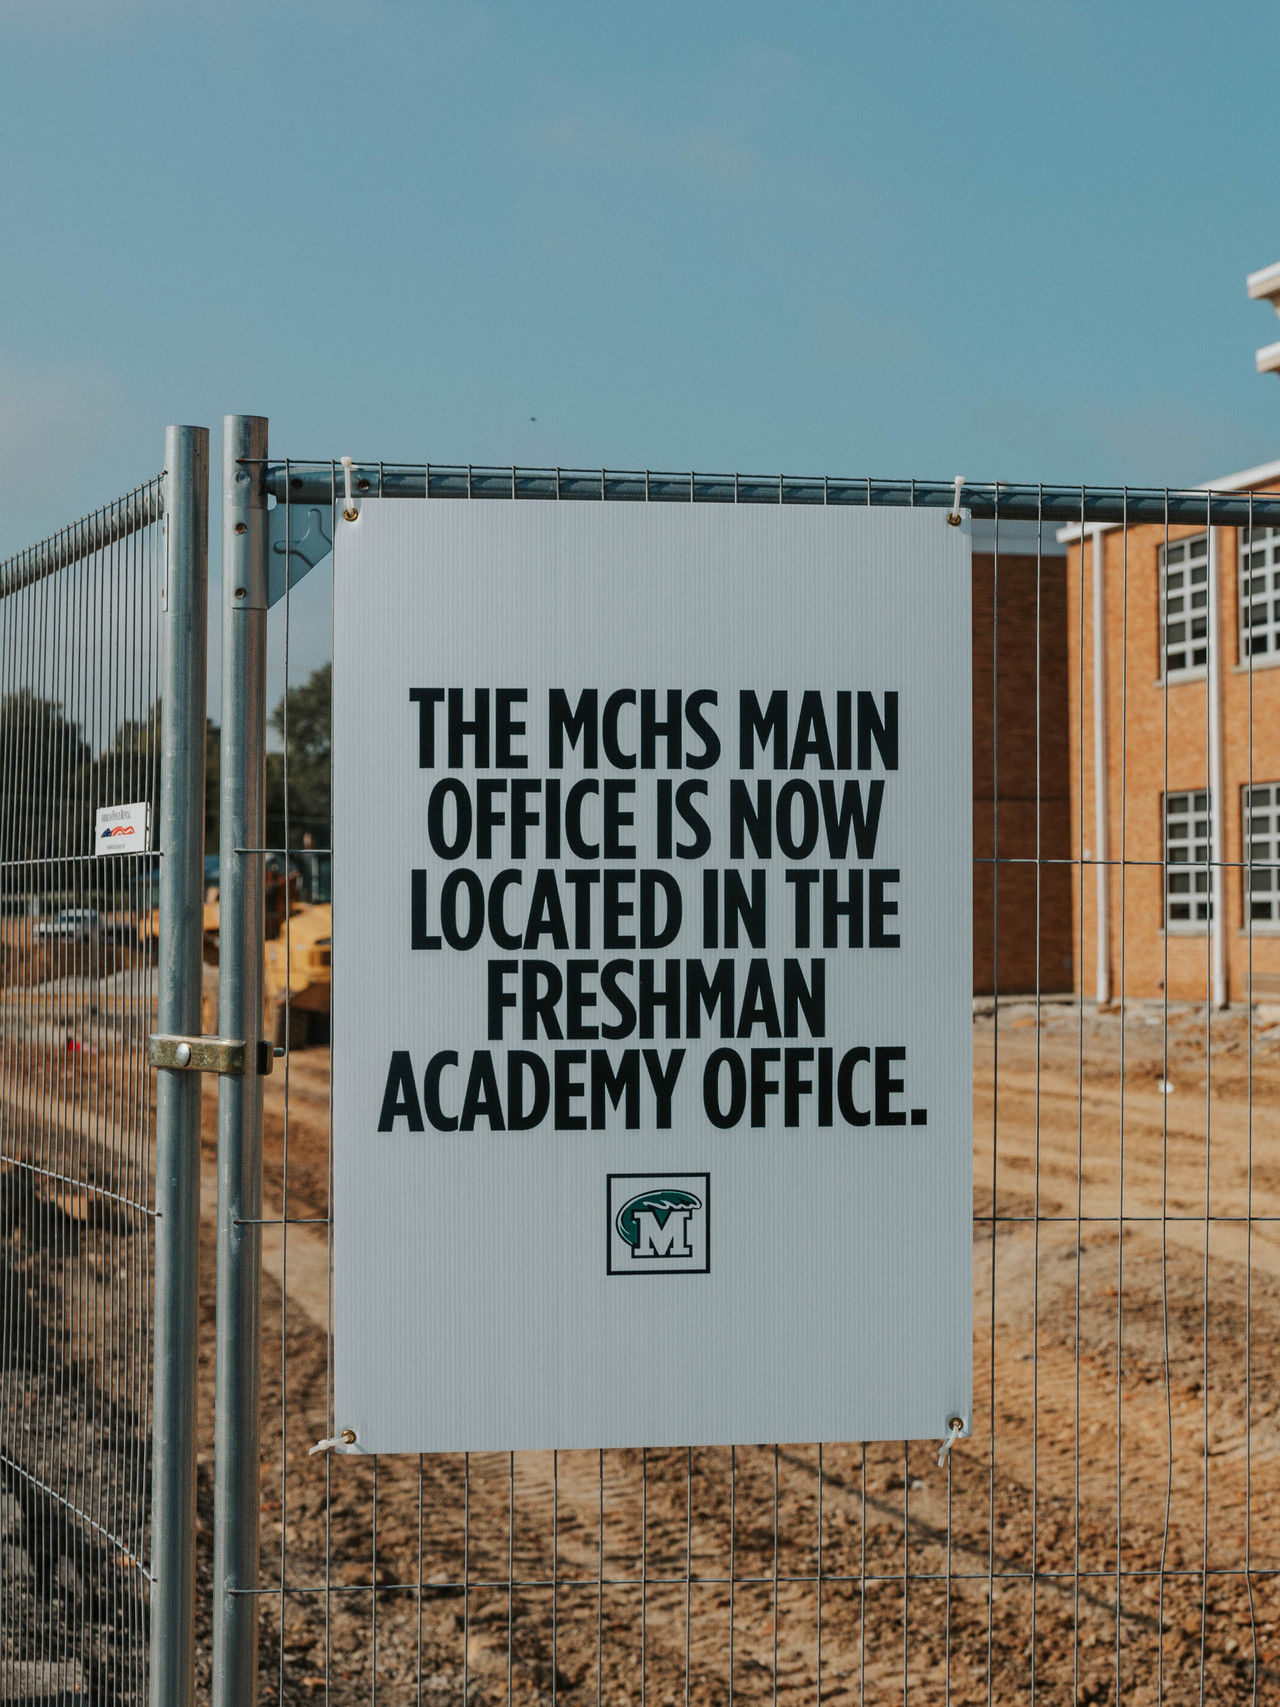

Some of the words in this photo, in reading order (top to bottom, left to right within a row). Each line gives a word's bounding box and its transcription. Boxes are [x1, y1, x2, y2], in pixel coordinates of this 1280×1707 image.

[410, 687, 529, 769] THE
[549, 688, 722, 771] MCHS
[740, 689, 899, 771] MAIN
[427, 777, 637, 861] OFFICE
[656, 778, 712, 860] IS
[729, 778, 886, 861] NOW
[411, 867, 683, 952] LOCATED
[702, 868, 767, 950] IN
[785, 868, 901, 949] THE
[487, 957, 826, 1041] FRESHMAN
[377, 1048, 687, 1133] ACADEMY
[702, 1046, 928, 1130] OFFICE.
[631, 1208, 693, 1259] M
